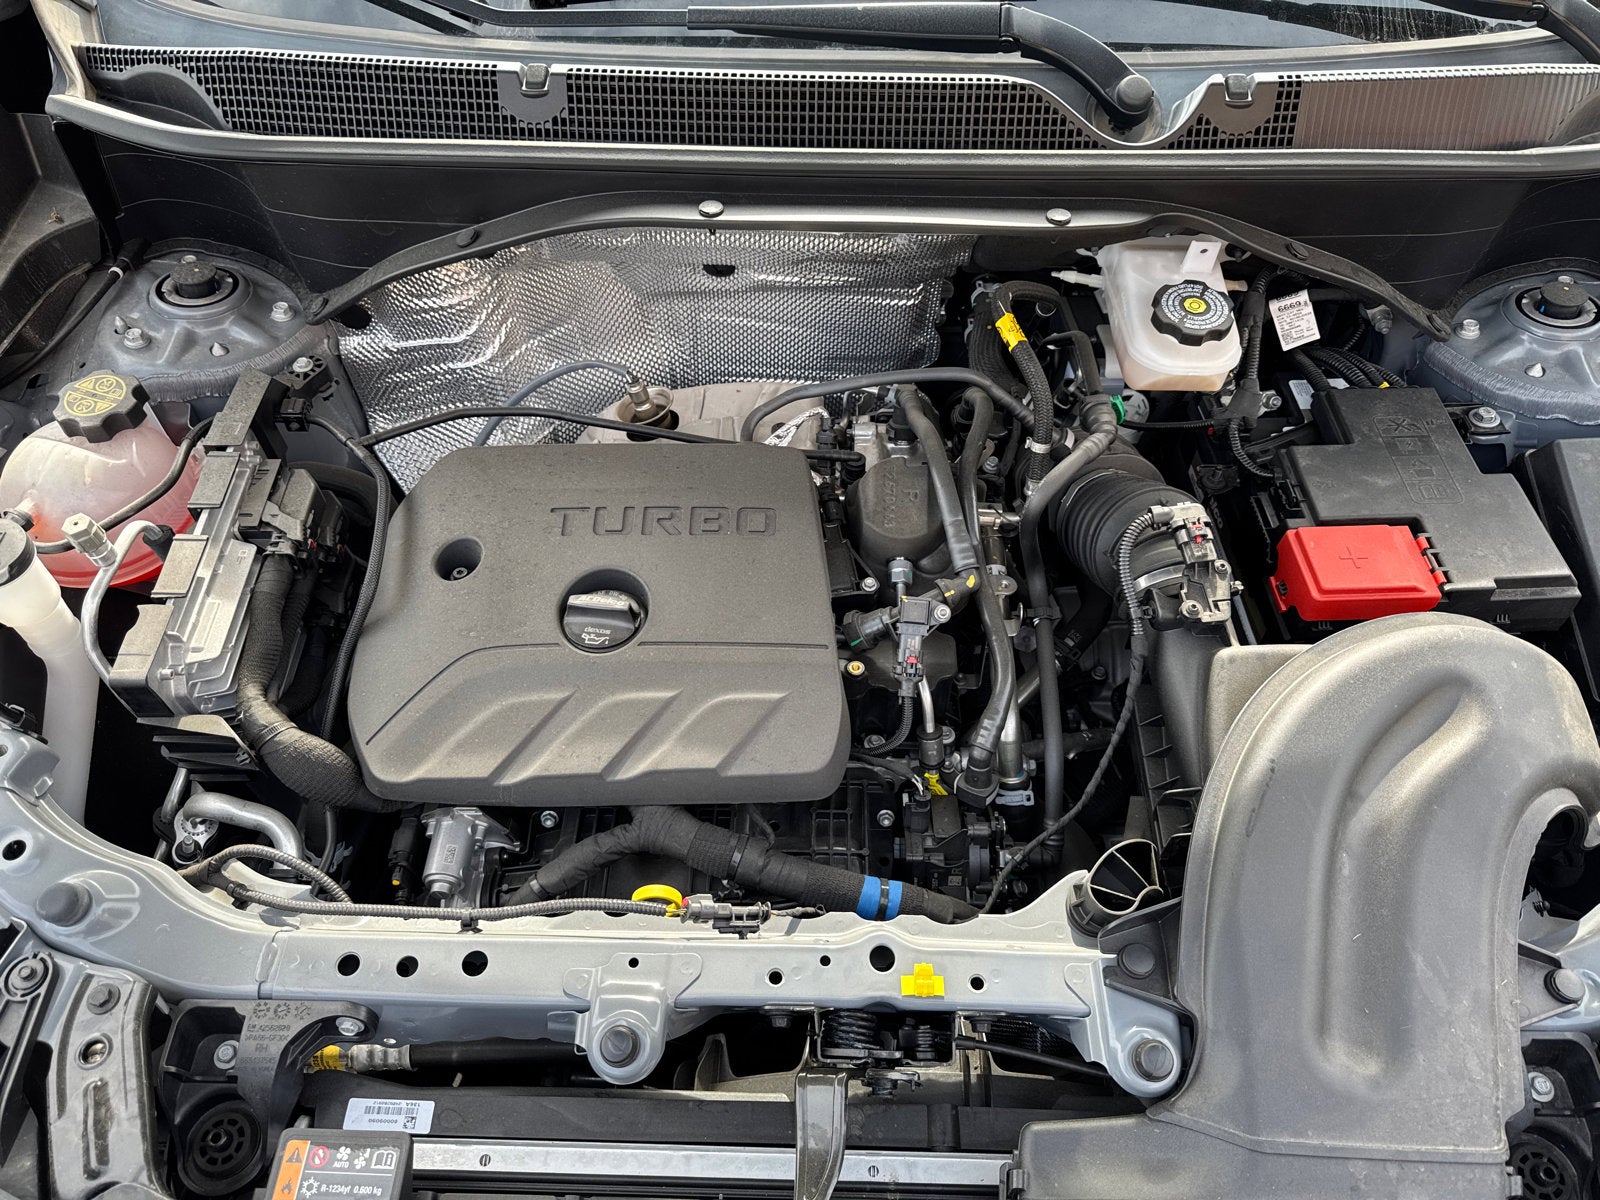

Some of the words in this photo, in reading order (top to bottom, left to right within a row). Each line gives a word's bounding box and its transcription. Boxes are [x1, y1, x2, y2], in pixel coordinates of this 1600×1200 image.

[550, 506, 778, 536] TURBO
[321, 1184, 351, 1195] R-1234yf
[353, 1185, 373, 1194] 0.600
[373, 1186, 382, 1196] kg
